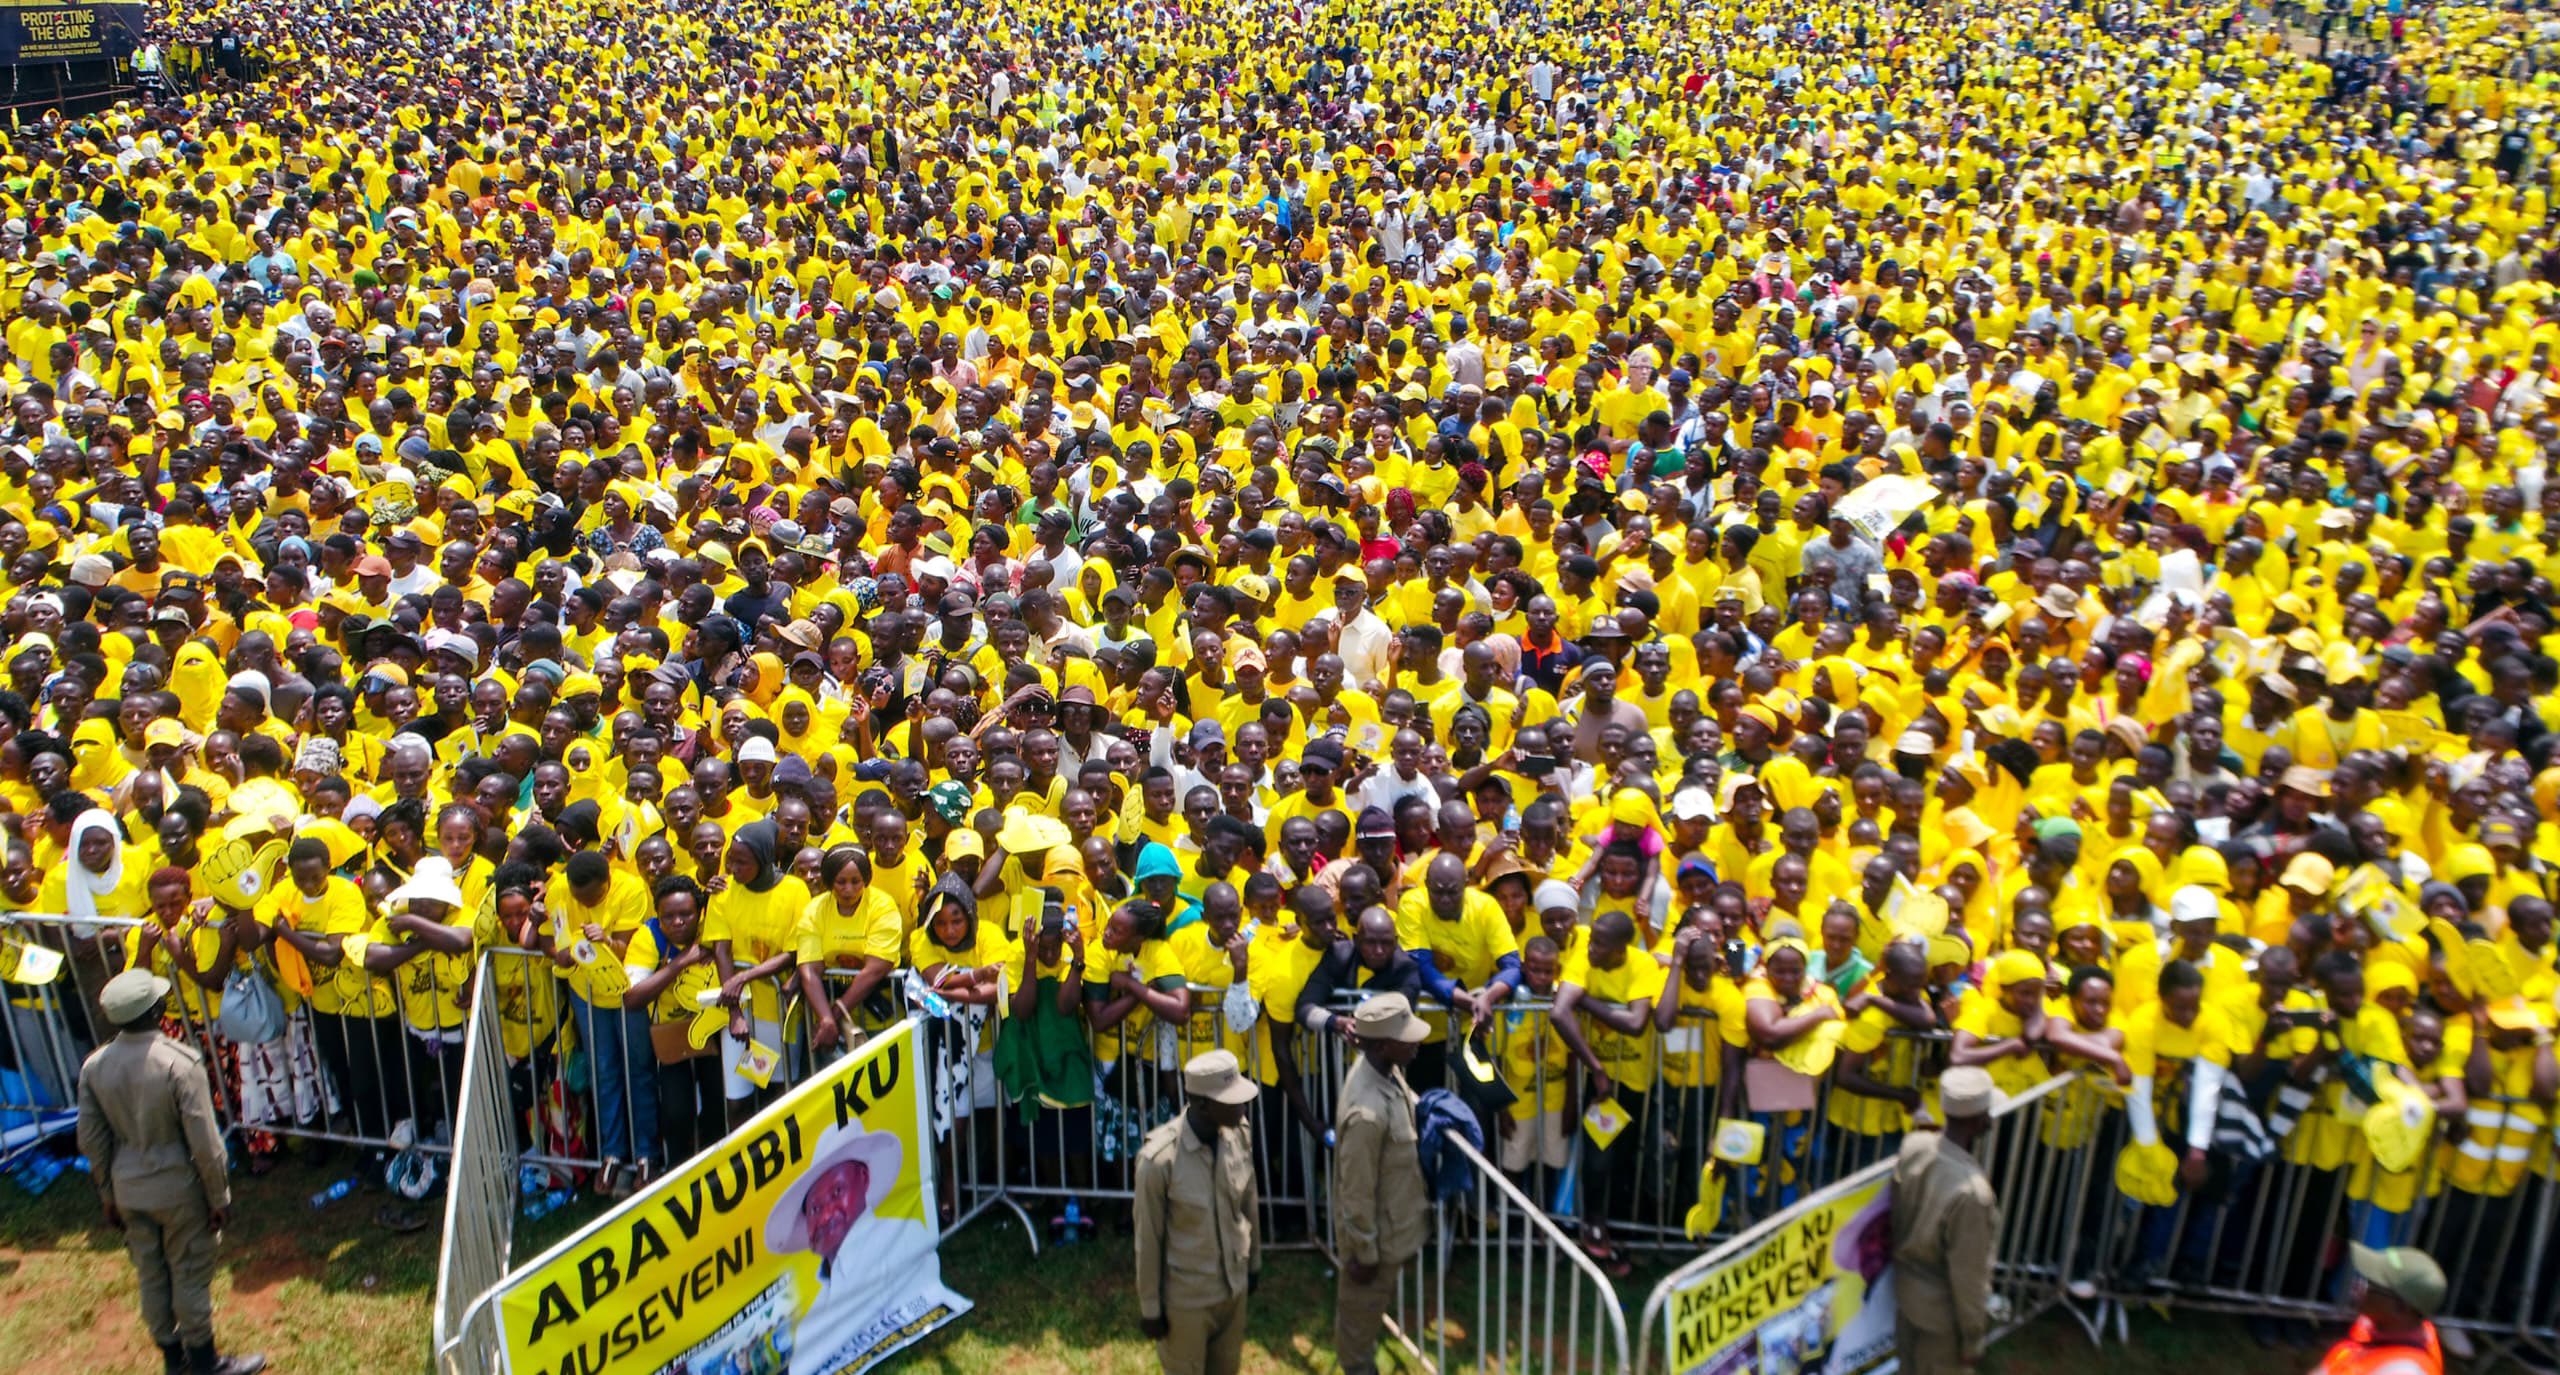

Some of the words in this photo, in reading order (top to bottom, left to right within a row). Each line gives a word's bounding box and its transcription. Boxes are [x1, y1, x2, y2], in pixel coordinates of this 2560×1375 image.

[20, 9, 95, 26] PROTECTING
[28, 26, 55, 41] THE
[56, 24, 91, 40] GAINS
[528, 1114, 803, 1346] ABAVUBI
[833, 1044, 900, 1130] KU
[1678, 1238, 1786, 1326] ABAVUBI
[1802, 1209, 1834, 1249] KU
[1678, 1244, 1829, 1365] MUSEVENI
